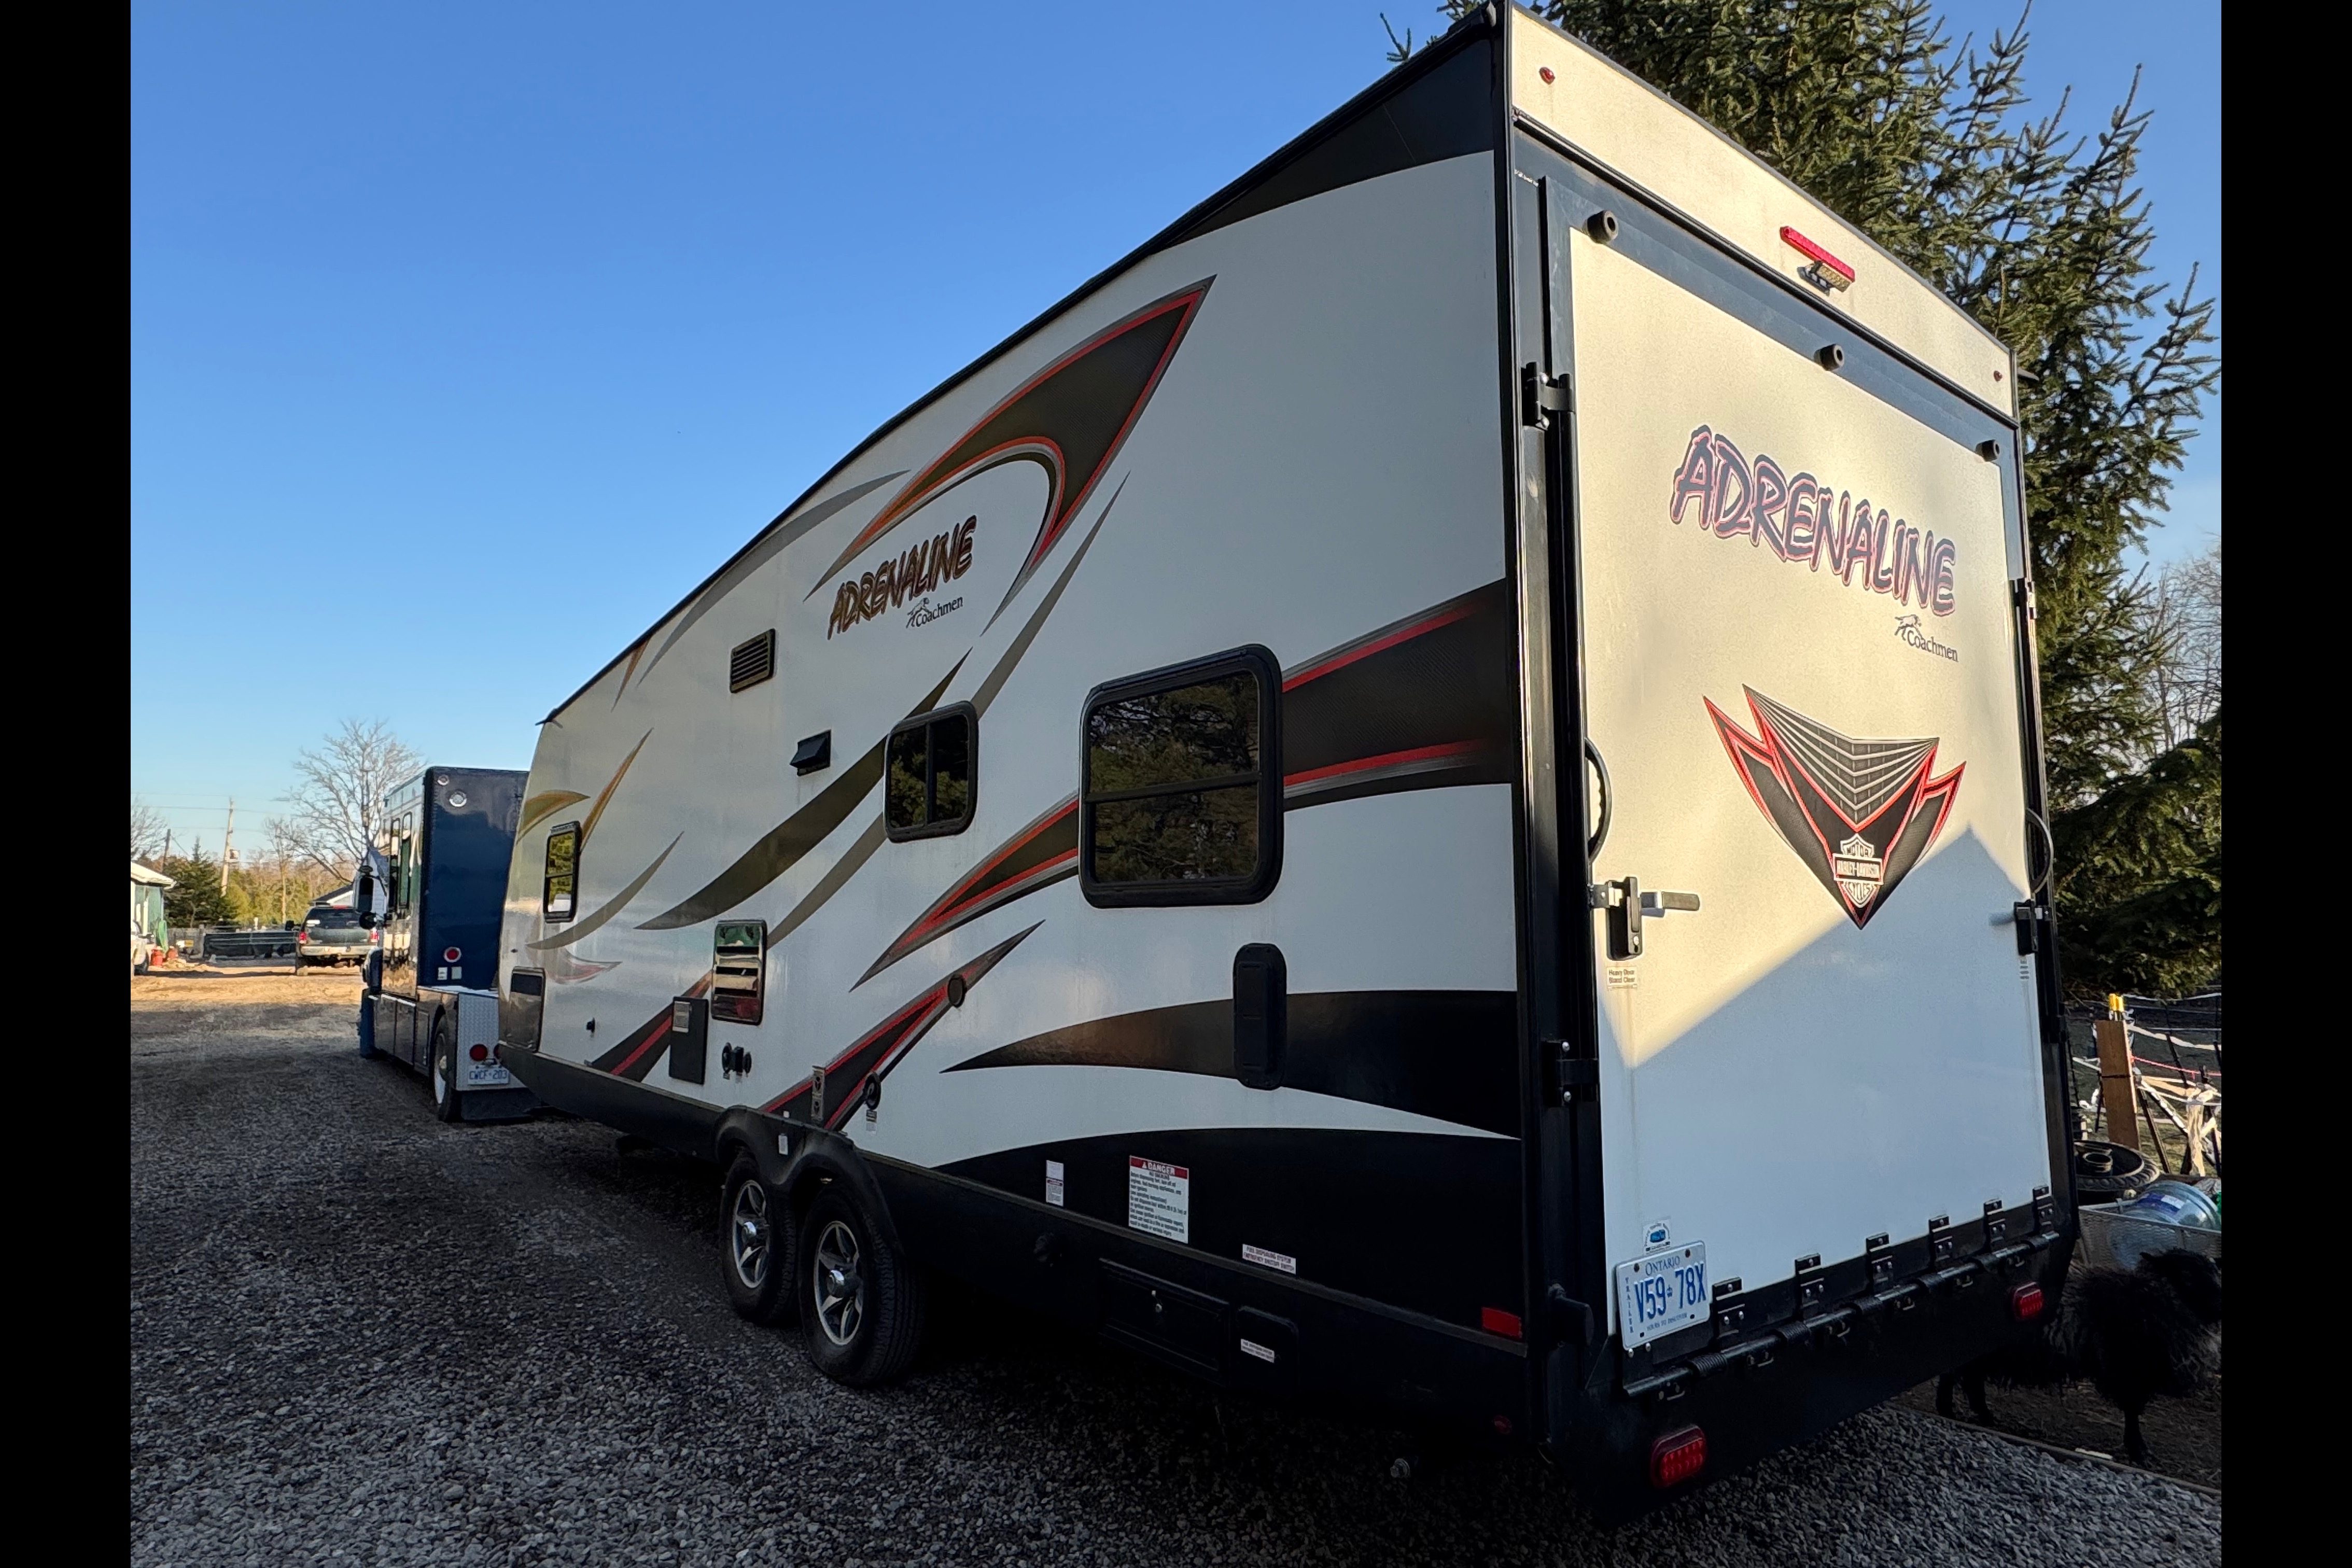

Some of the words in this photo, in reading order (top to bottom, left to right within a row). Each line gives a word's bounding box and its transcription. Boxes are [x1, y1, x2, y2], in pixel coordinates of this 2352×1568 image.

[1670, 424, 1955, 616] ADRENALINE
[827, 514, 977, 640] ADRENALINE
[916, 597, 963, 627] Coachmen
[1908, 630, 1958, 662] Coachmen
[1147, 1162, 1175, 1176] DANGER
[1625, 1277, 1634, 1333] TRAILER
